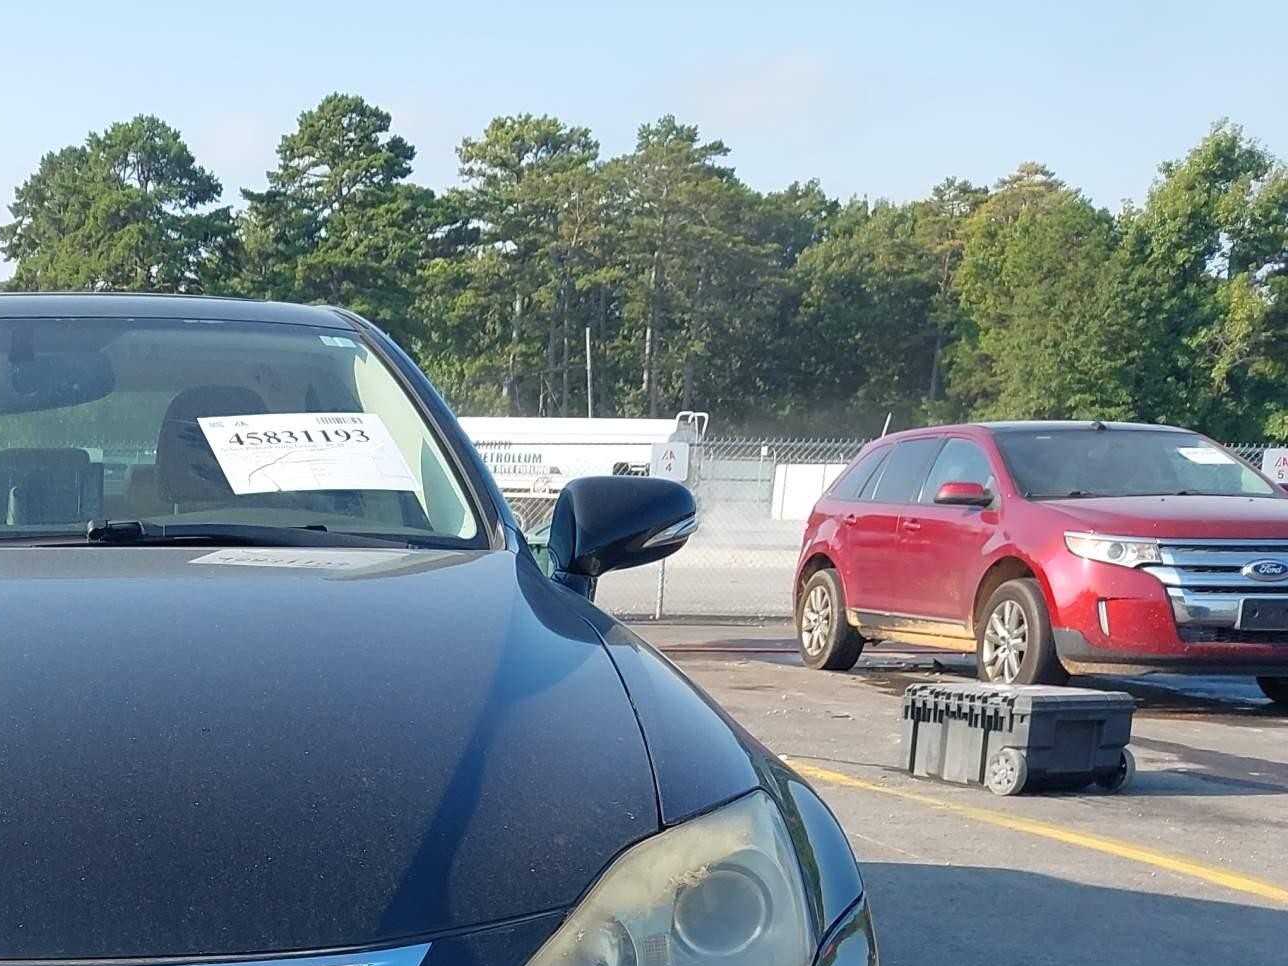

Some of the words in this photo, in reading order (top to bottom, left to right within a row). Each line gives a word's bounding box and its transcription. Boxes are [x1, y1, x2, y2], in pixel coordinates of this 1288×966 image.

[228, 428, 371, 446] 45831193
[1277, 470, 1285, 480] 5
[1258, 563, 1283, 574] Ford
